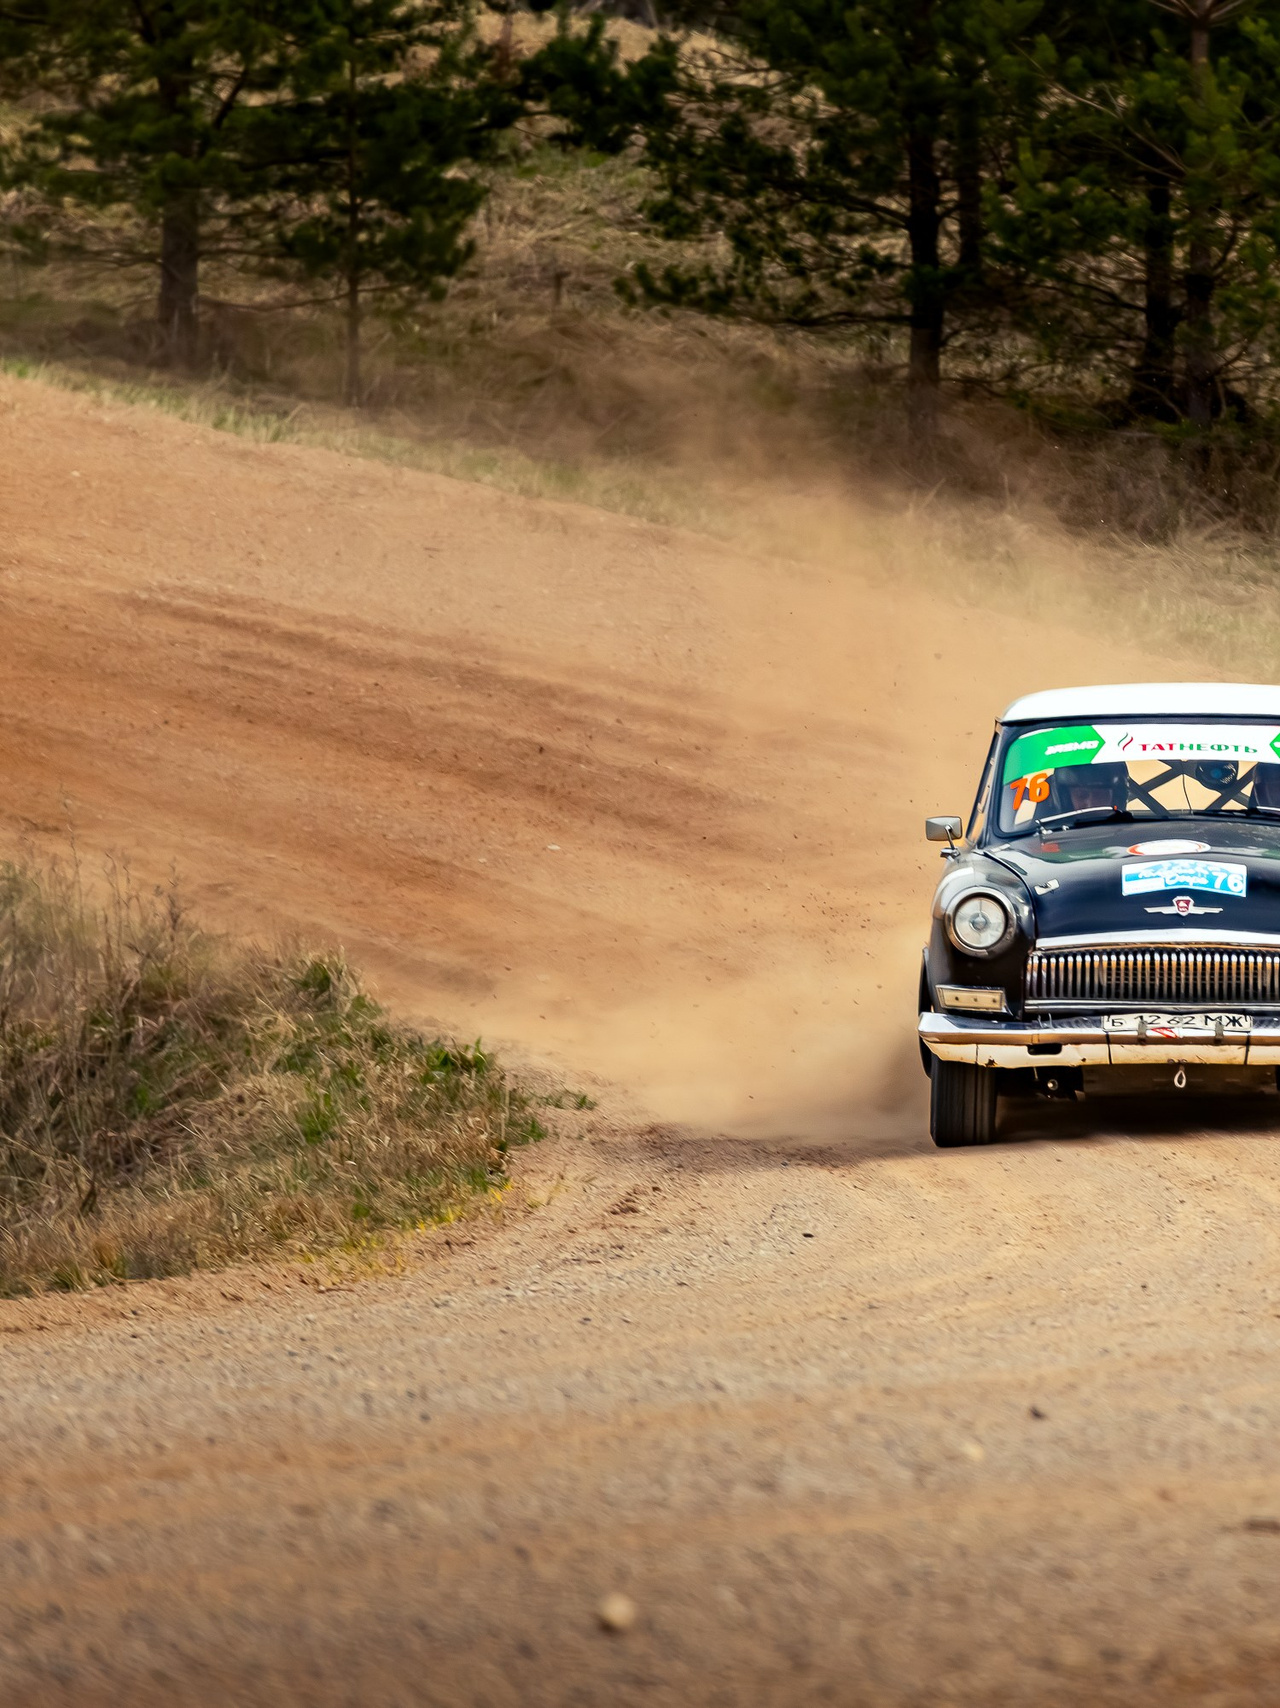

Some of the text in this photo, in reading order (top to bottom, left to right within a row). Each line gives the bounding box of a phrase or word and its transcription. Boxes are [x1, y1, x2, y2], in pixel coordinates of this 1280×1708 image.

[1138, 743, 1258, 753] ТАТНЕФТЬ
[1010, 772, 1050, 811] 76
[1212, 871, 1244, 893] 76
[1111, 1017, 1125, 1027] Б
[1203, 1014, 1244, 1027] МЖ
